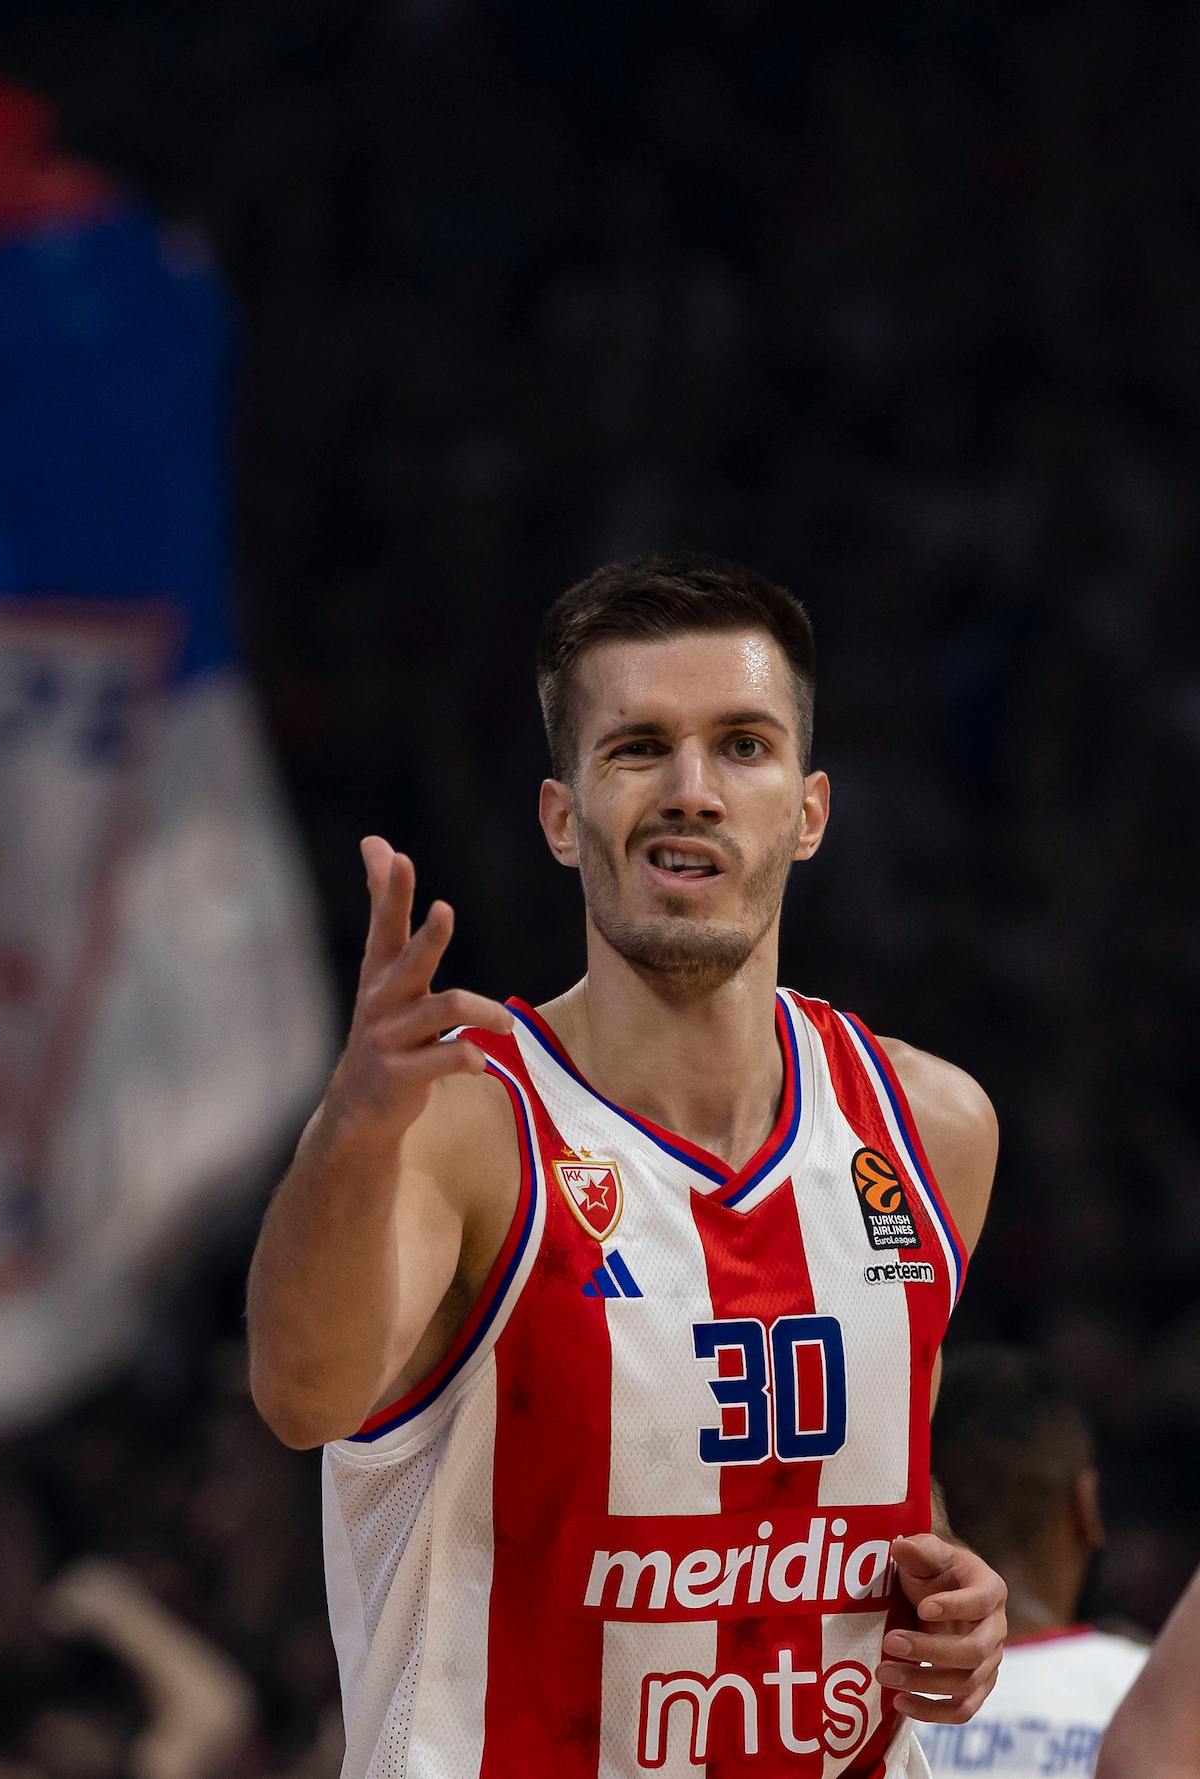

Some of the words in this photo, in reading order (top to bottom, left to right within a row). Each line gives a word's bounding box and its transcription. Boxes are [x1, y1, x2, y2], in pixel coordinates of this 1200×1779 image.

[565, 1170, 585, 1182] KK
[869, 1215, 910, 1225] TURKISH
[873, 1226, 913, 1236] AIRLINES
[874, 1237, 916, 1246] EuroLeague
[692, 1314, 847, 1467] 30
[582, 1517, 904, 1610] meridia
[639, 1648, 872, 1768] mts
